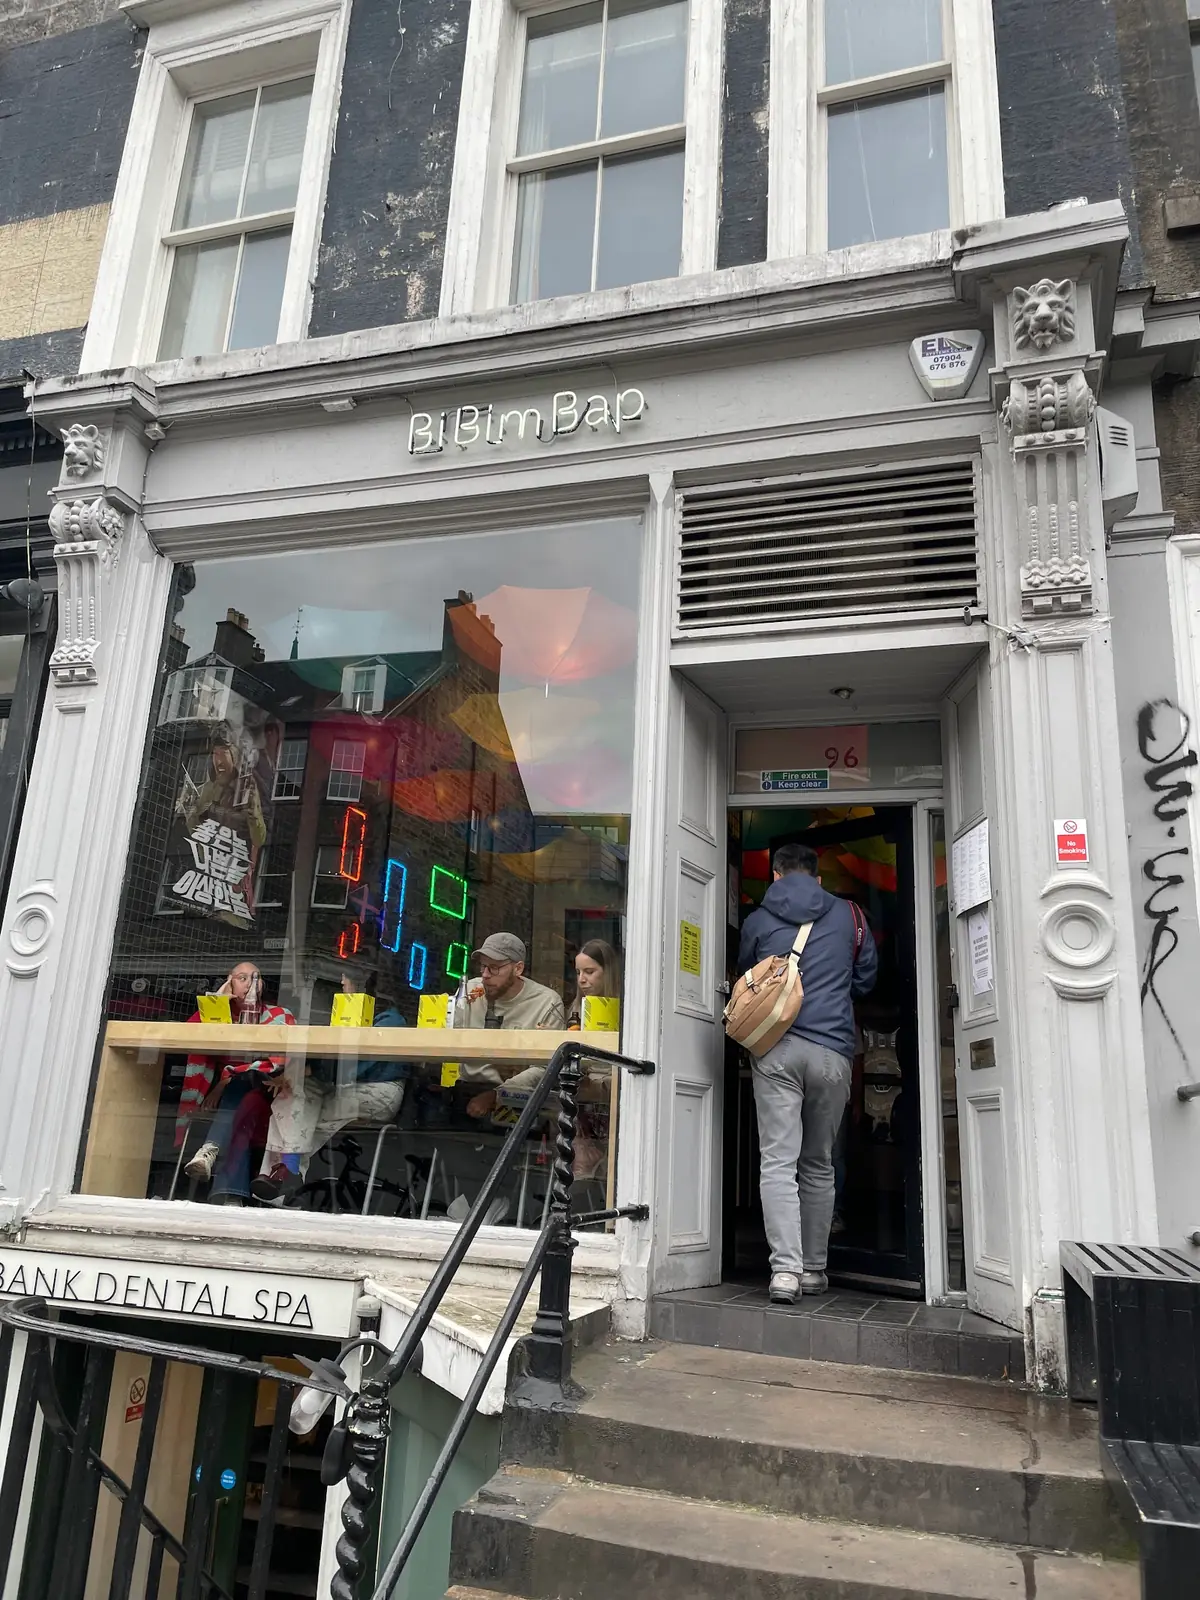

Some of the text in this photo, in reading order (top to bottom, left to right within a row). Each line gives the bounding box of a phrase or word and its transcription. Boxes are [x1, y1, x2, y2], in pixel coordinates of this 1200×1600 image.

[933, 354, 961, 363] 07904
[929, 360, 966, 371] 676 876
[824, 746, 859, 769] 96
[782, 772, 800, 780] Fire
[778, 780, 822, 789] Keep clear
[94, 1272, 236, 1318] DENTAL
[253, 1289, 313, 1328] SPA
